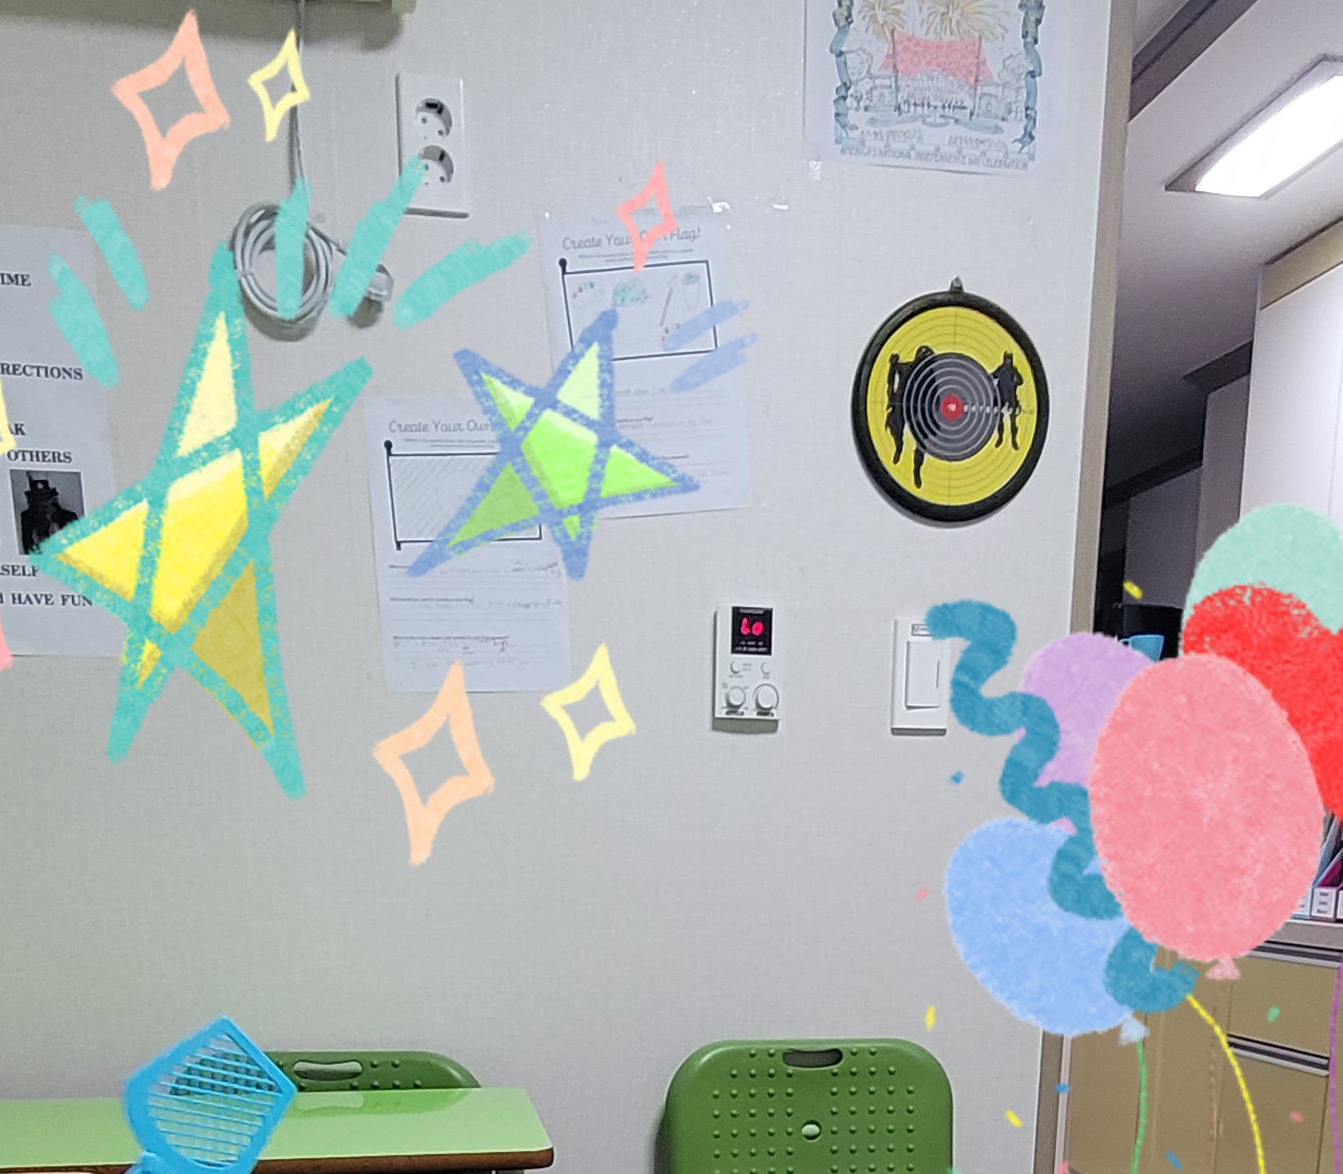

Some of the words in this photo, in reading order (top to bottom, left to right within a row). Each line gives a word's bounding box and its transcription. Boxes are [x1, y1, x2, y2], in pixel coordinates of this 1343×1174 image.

[562, 235, 604, 250] Create
[387, 419, 431, 433] Create
[6, 449, 73, 465] OTHERS
[11, 592, 56, 607] HAVE
[60, 593, 94, 608] FUN
